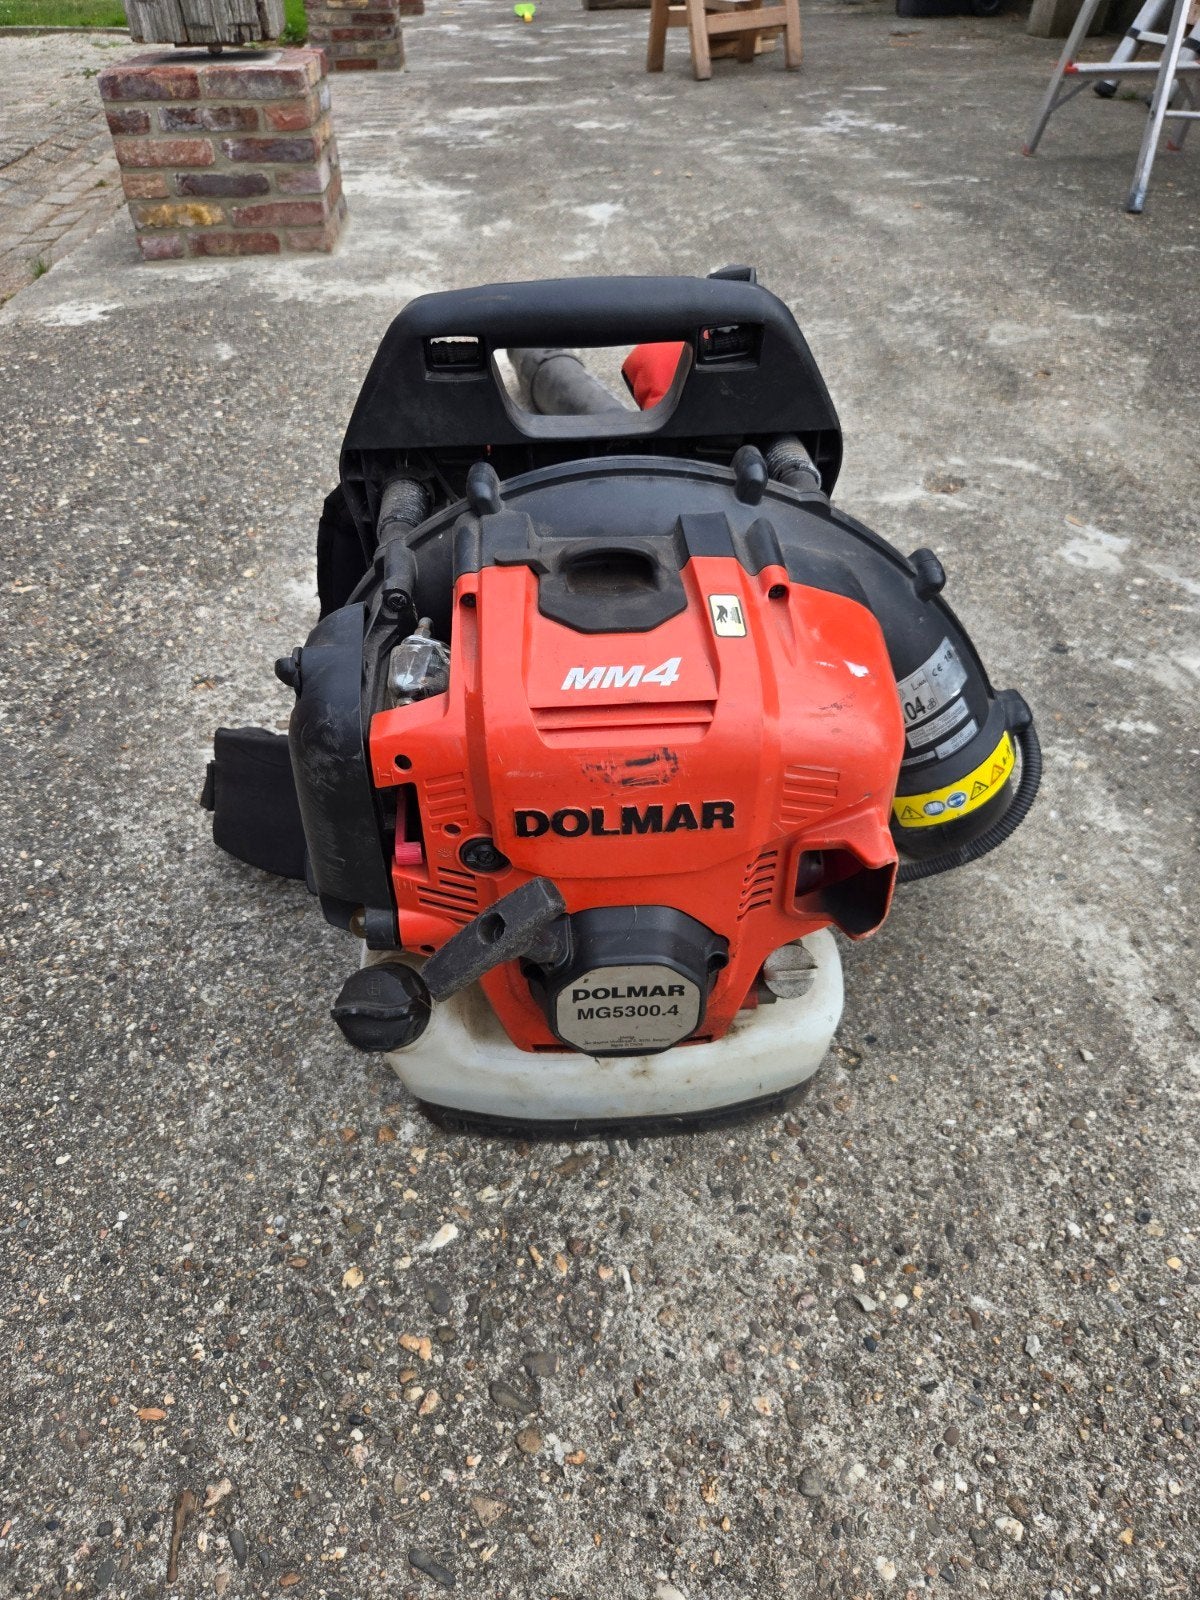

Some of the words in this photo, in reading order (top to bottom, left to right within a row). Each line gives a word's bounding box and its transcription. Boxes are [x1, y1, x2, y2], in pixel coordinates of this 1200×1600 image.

[560, 656, 682, 691] MM4
[904, 695, 926, 722] 04
[513, 799, 736, 838] DOLMAR
[572, 984, 685, 1003] DOLMAR
[577, 1004, 679, 1021] MG5300.4
